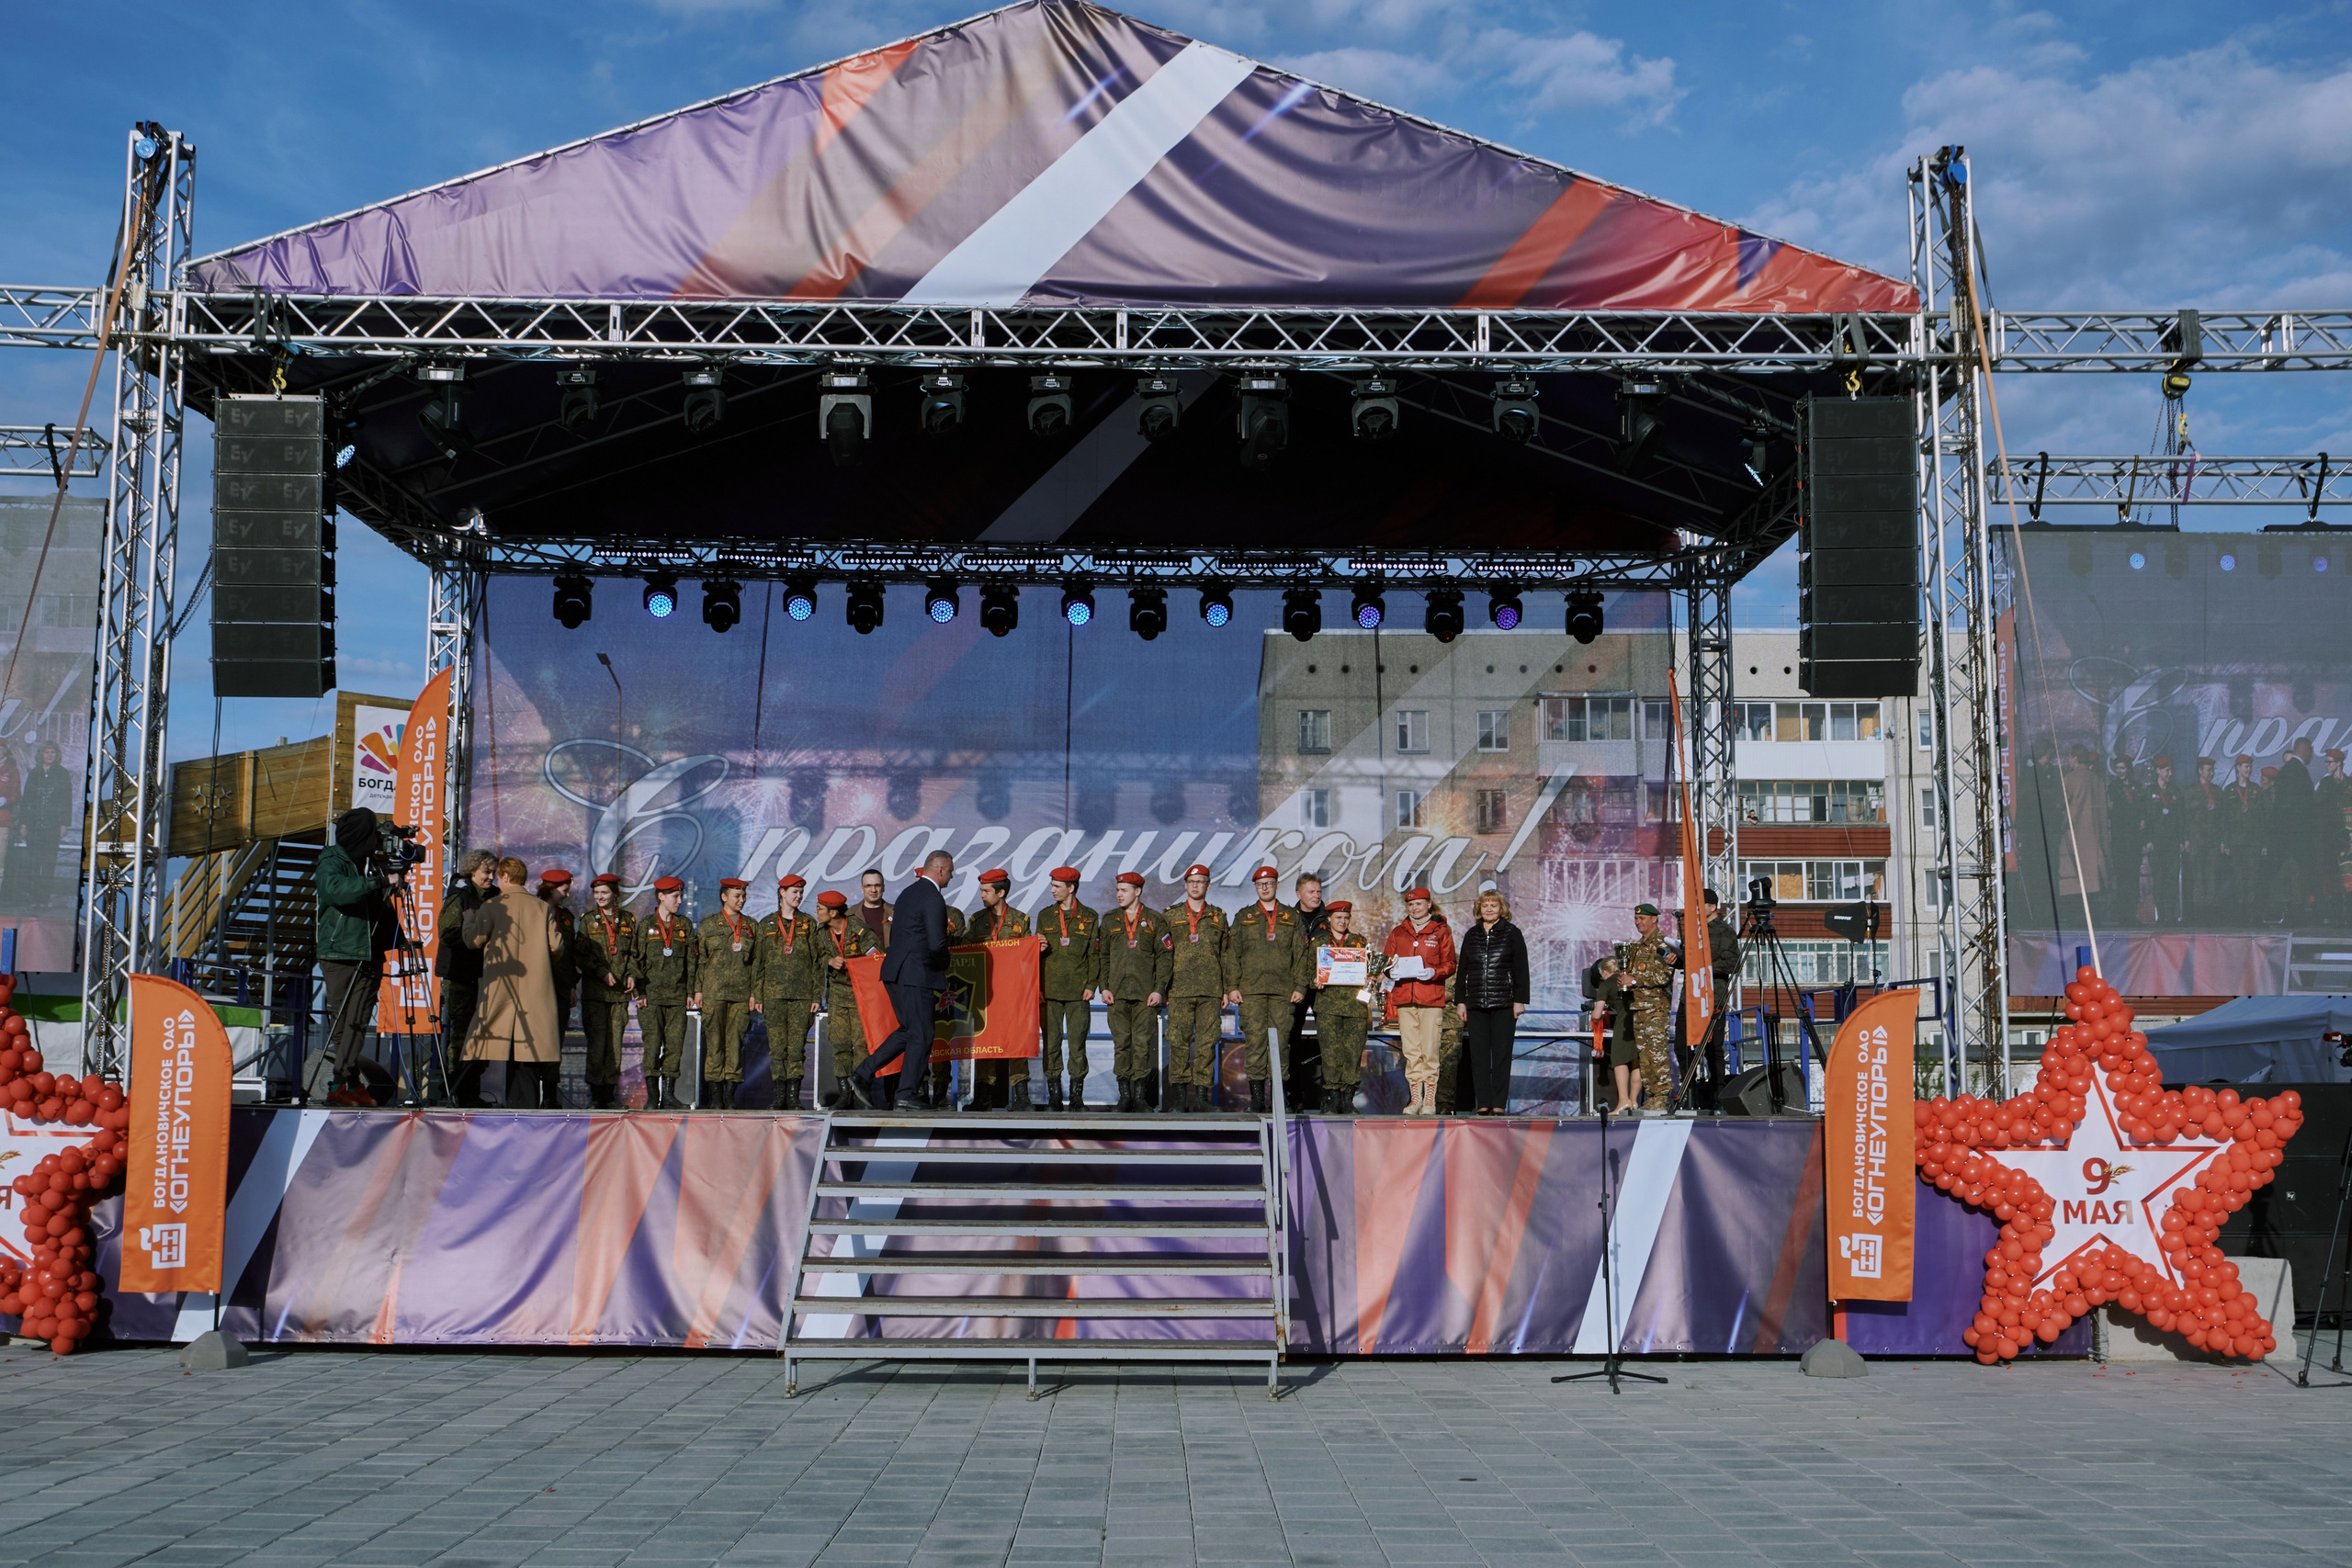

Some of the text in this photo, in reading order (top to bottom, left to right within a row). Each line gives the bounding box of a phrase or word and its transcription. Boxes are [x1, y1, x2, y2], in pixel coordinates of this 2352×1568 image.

[414, 725, 424, 763] ОАО
[359, 778, 396, 792] БОГД
[544, 739, 729, 908] С
[990, 939, 1020, 948] РАЙОН
[950, 957, 976, 967] ГАРД
[931, 1045, 1004, 1057] ОВСКАЯ ОБЛАСТЬ
[153, 1017, 175, 1208] БОГДАНОВИЧСКОЕ ОАО
[1852, 1029, 1870, 1218] БОГДАНОВИЧСКОЕ ОАО
[2082, 1157, 2111, 1195] 9
[2063, 1200, 2134, 1224] МАЯ
